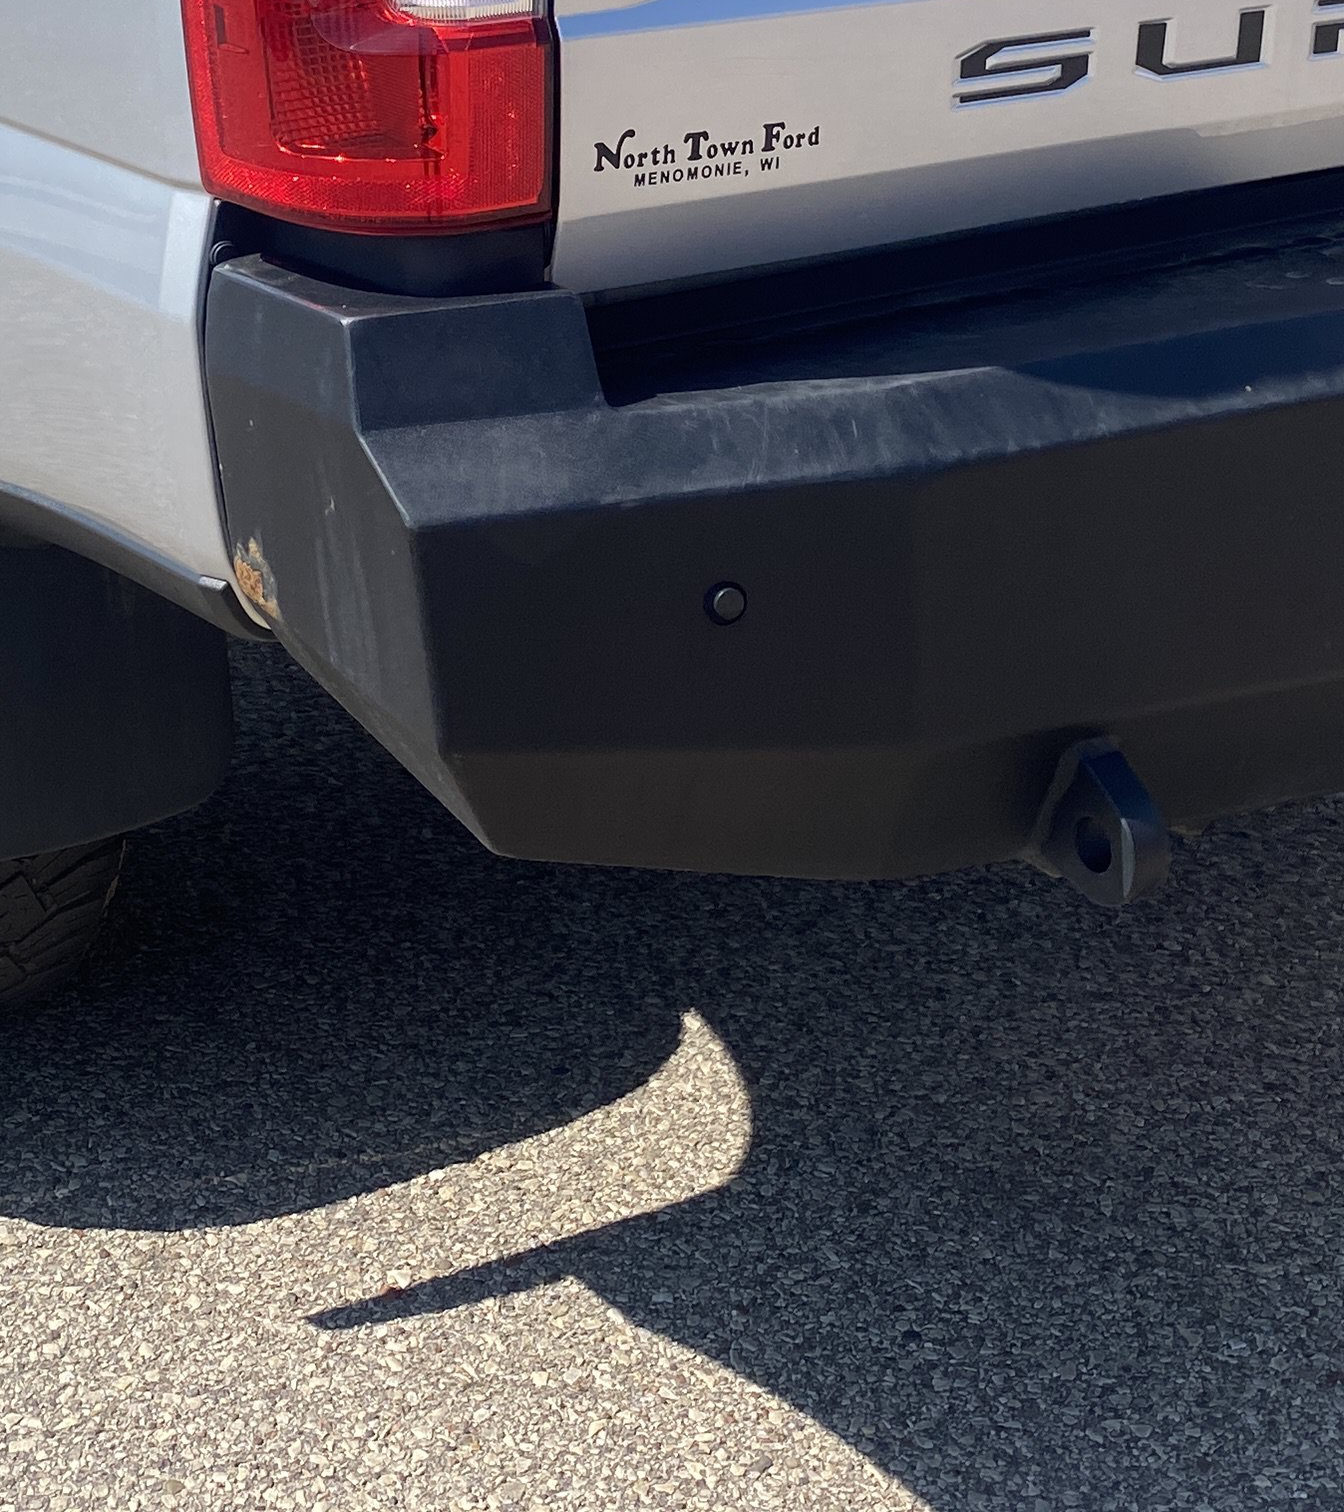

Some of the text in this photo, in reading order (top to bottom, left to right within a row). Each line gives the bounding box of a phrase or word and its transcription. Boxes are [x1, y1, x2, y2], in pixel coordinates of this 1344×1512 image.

[593, 121, 820, 172] North Town Ford
[634, 157, 780, 187] MENOMONIE, WI
